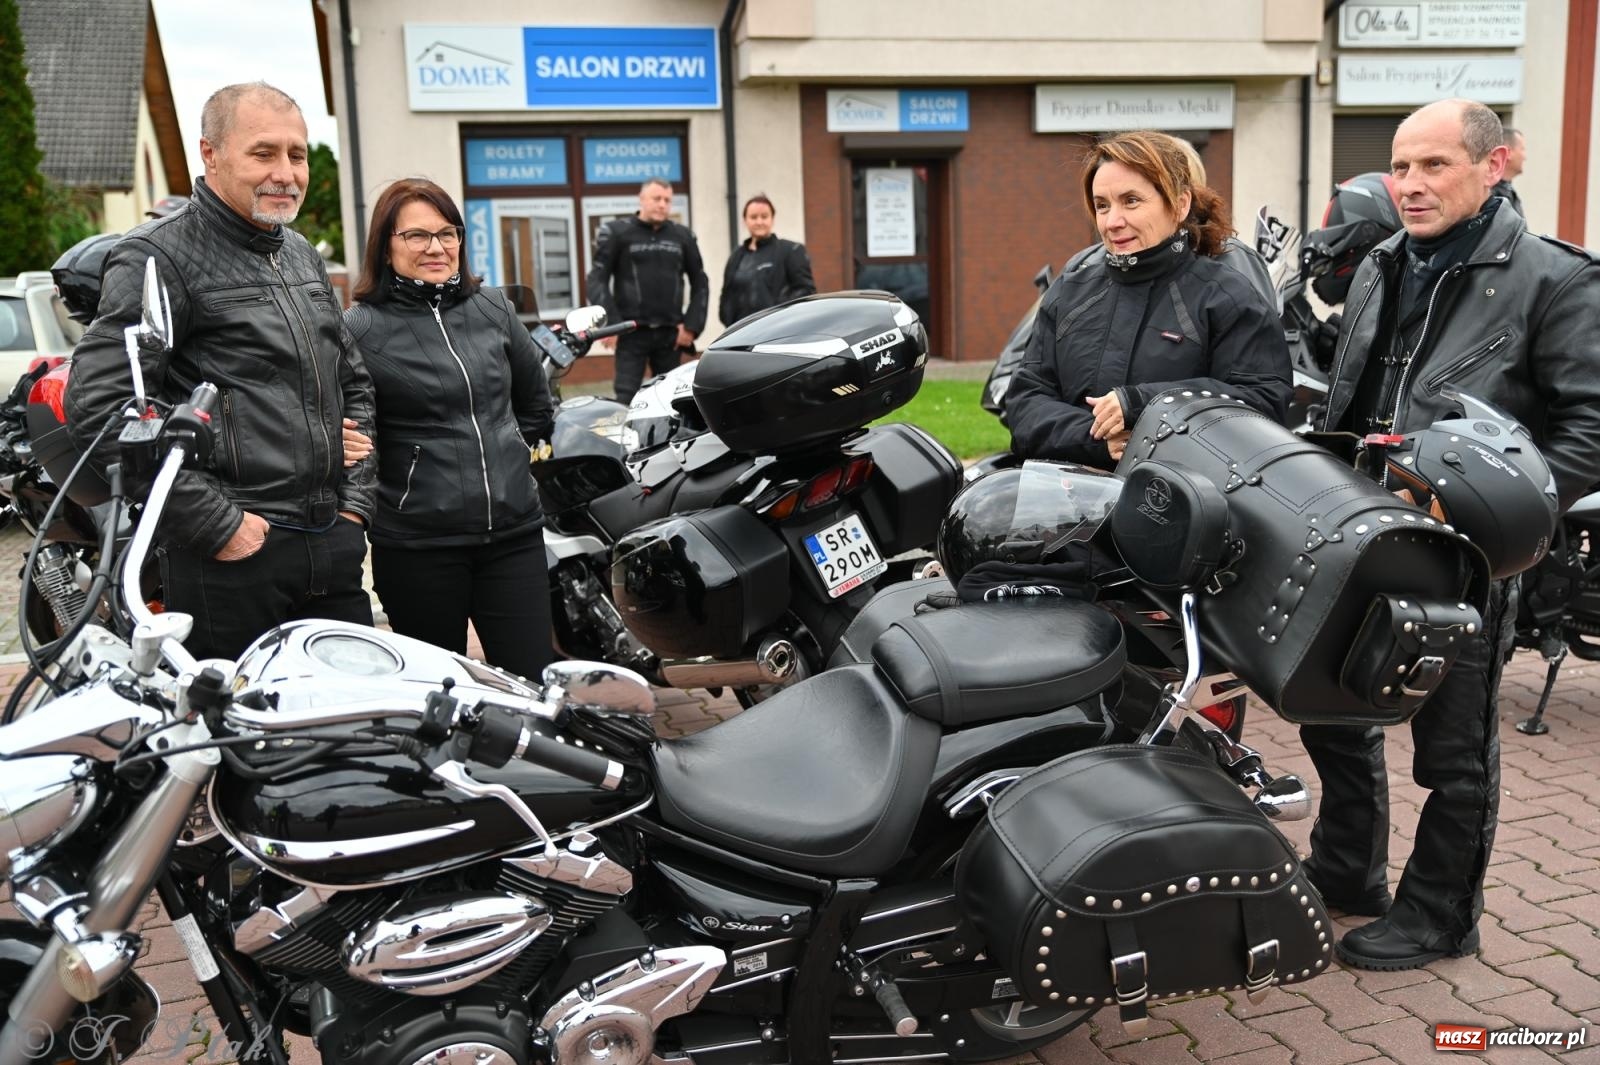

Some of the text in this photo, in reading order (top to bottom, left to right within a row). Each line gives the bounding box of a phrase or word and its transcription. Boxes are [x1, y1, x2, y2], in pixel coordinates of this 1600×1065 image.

[535, 56, 706, 78] SALON DRZWI
[418, 67, 510, 86] DOMEK
[910, 97, 957, 110] SALON
[1051, 101, 1101, 119] Fryzjer
[1106, 99, 1164, 116] Damsko
[910, 111, 957, 124] DRZWI
[485, 145, 545, 159] ROLETY
[488, 165, 545, 180] BRAMY
[594, 163, 671, 178] PARAPETY
[860, 333, 897, 354] SHAD
[825, 527, 852, 551] SR
[813, 551, 826, 564] PL
[824, 543, 876, 583] 290M
[722, 921, 773, 932] Star
